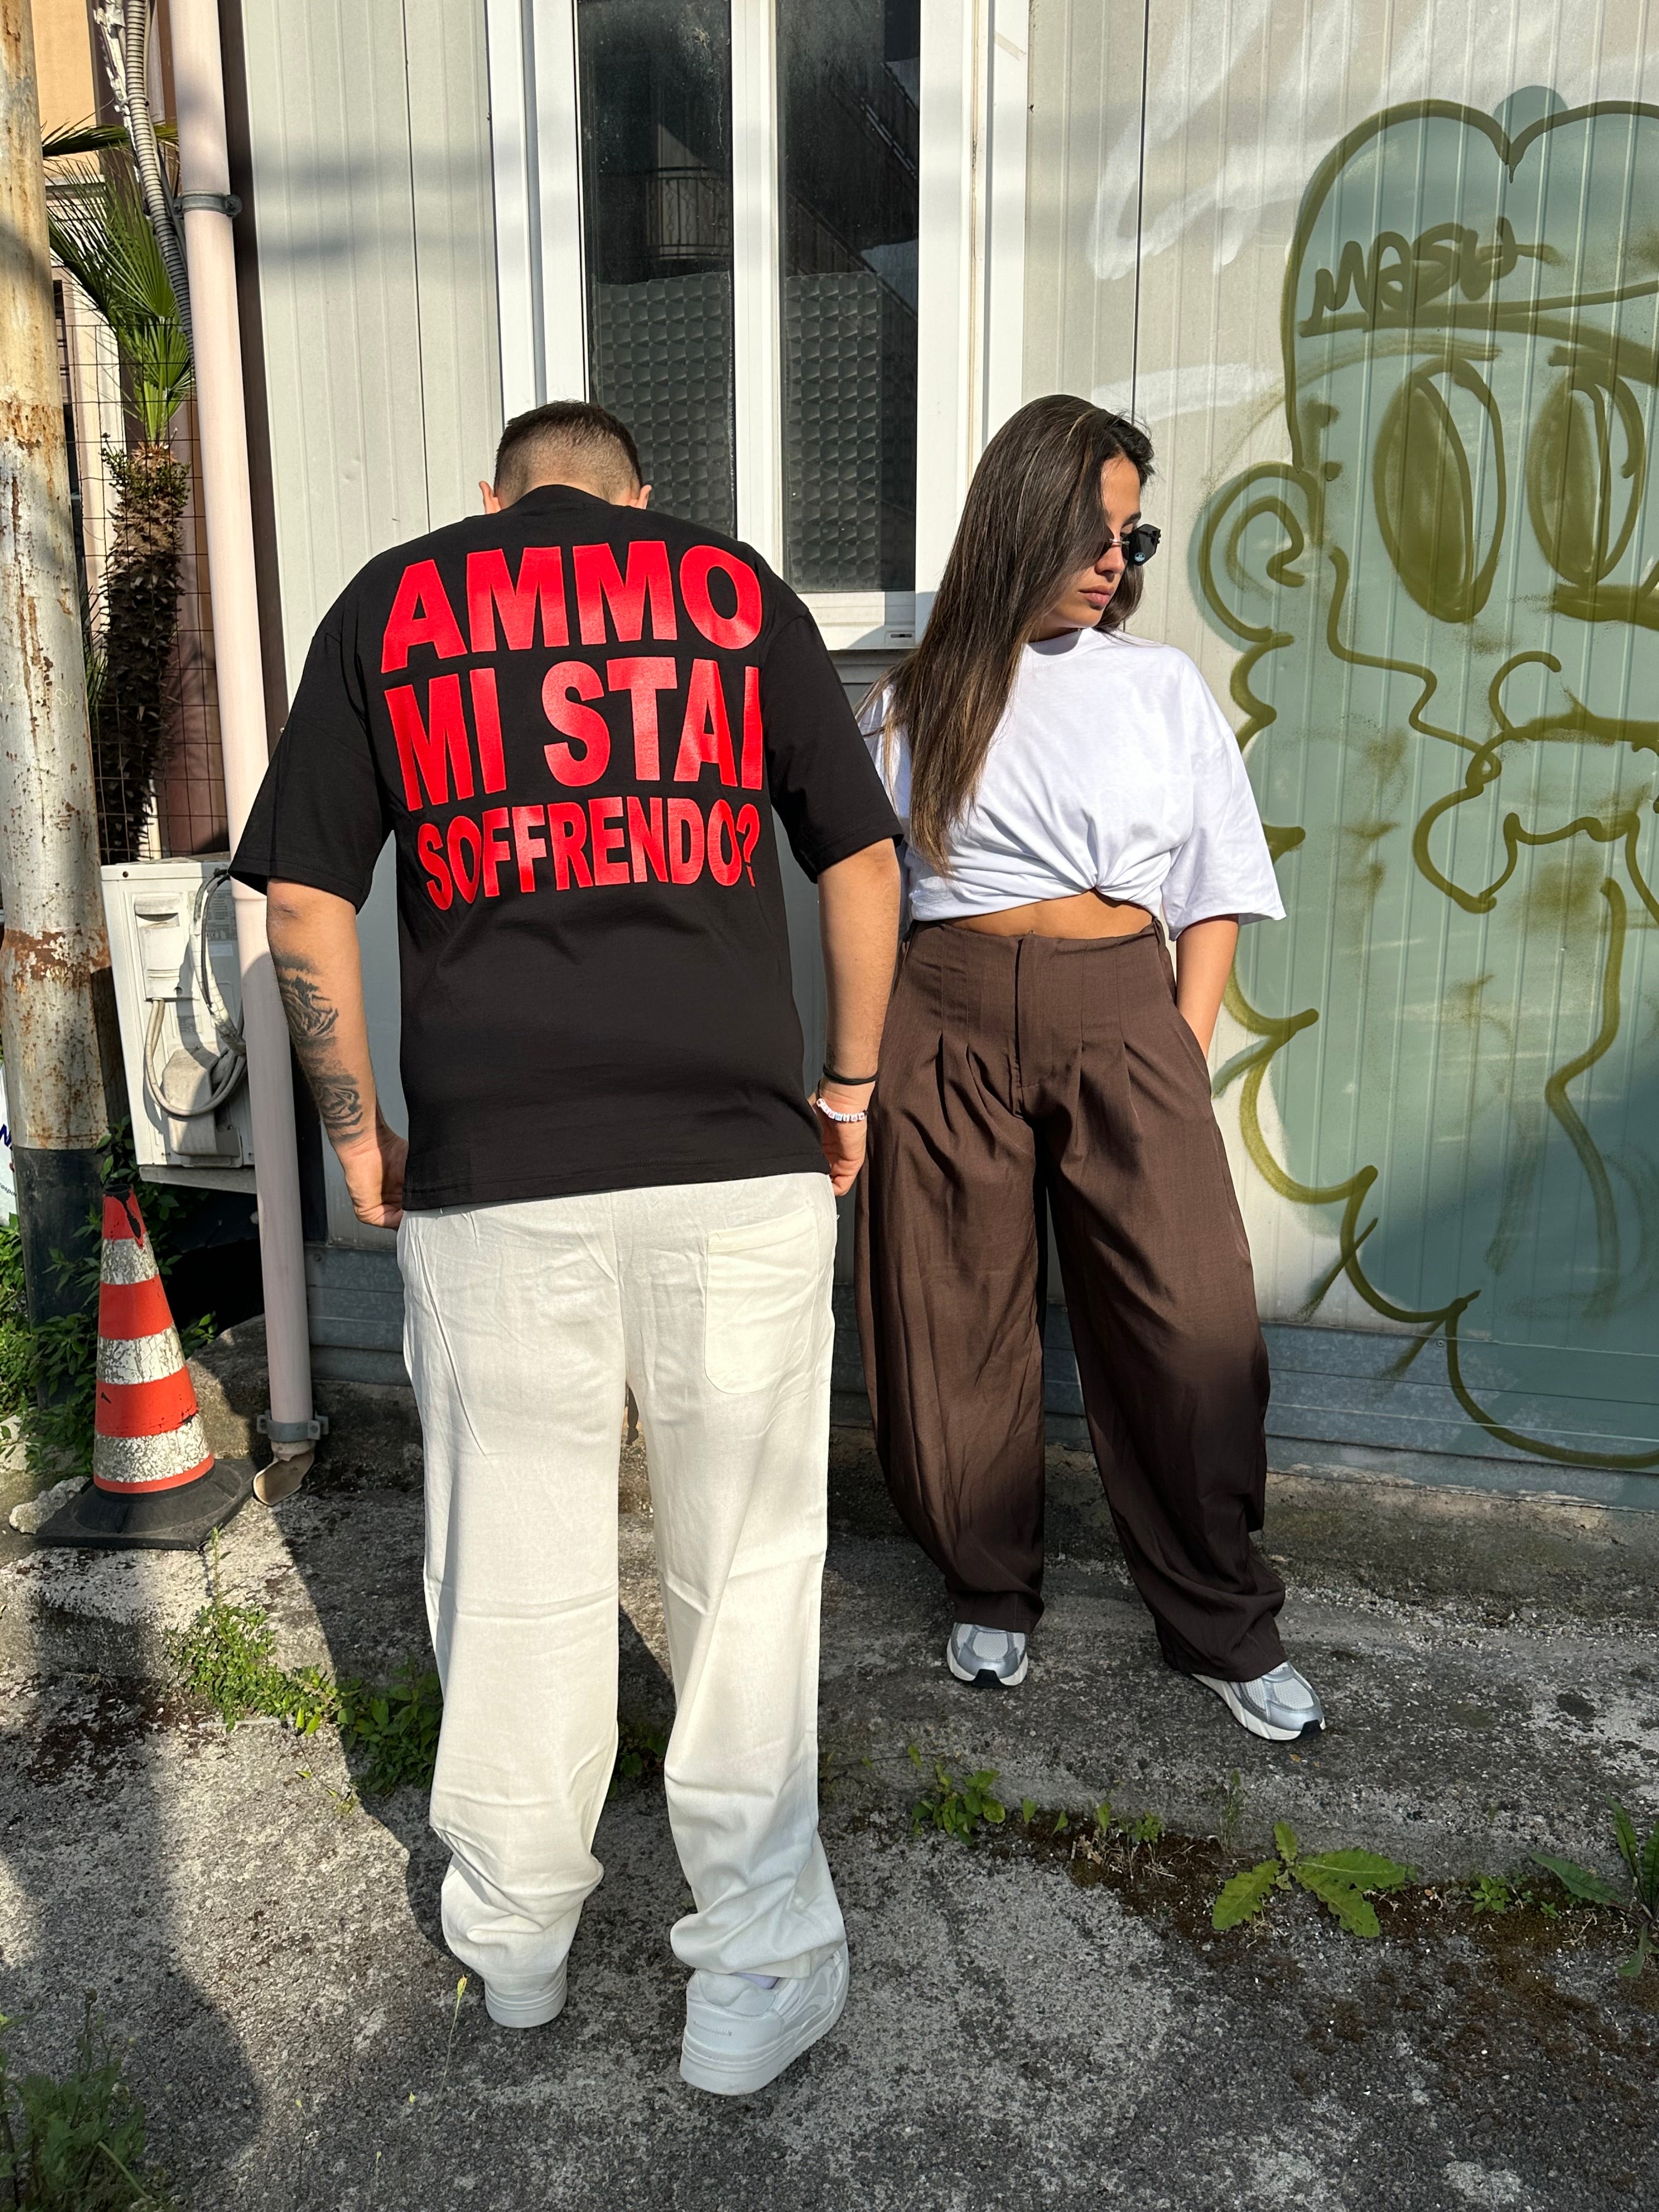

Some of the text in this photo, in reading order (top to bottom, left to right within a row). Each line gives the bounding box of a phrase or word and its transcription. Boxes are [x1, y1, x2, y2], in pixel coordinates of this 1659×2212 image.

[380, 540, 763, 674] AMMO
[383, 656, 764, 812] MI STAI
[417, 795, 761, 911] SOFFRENDO?
